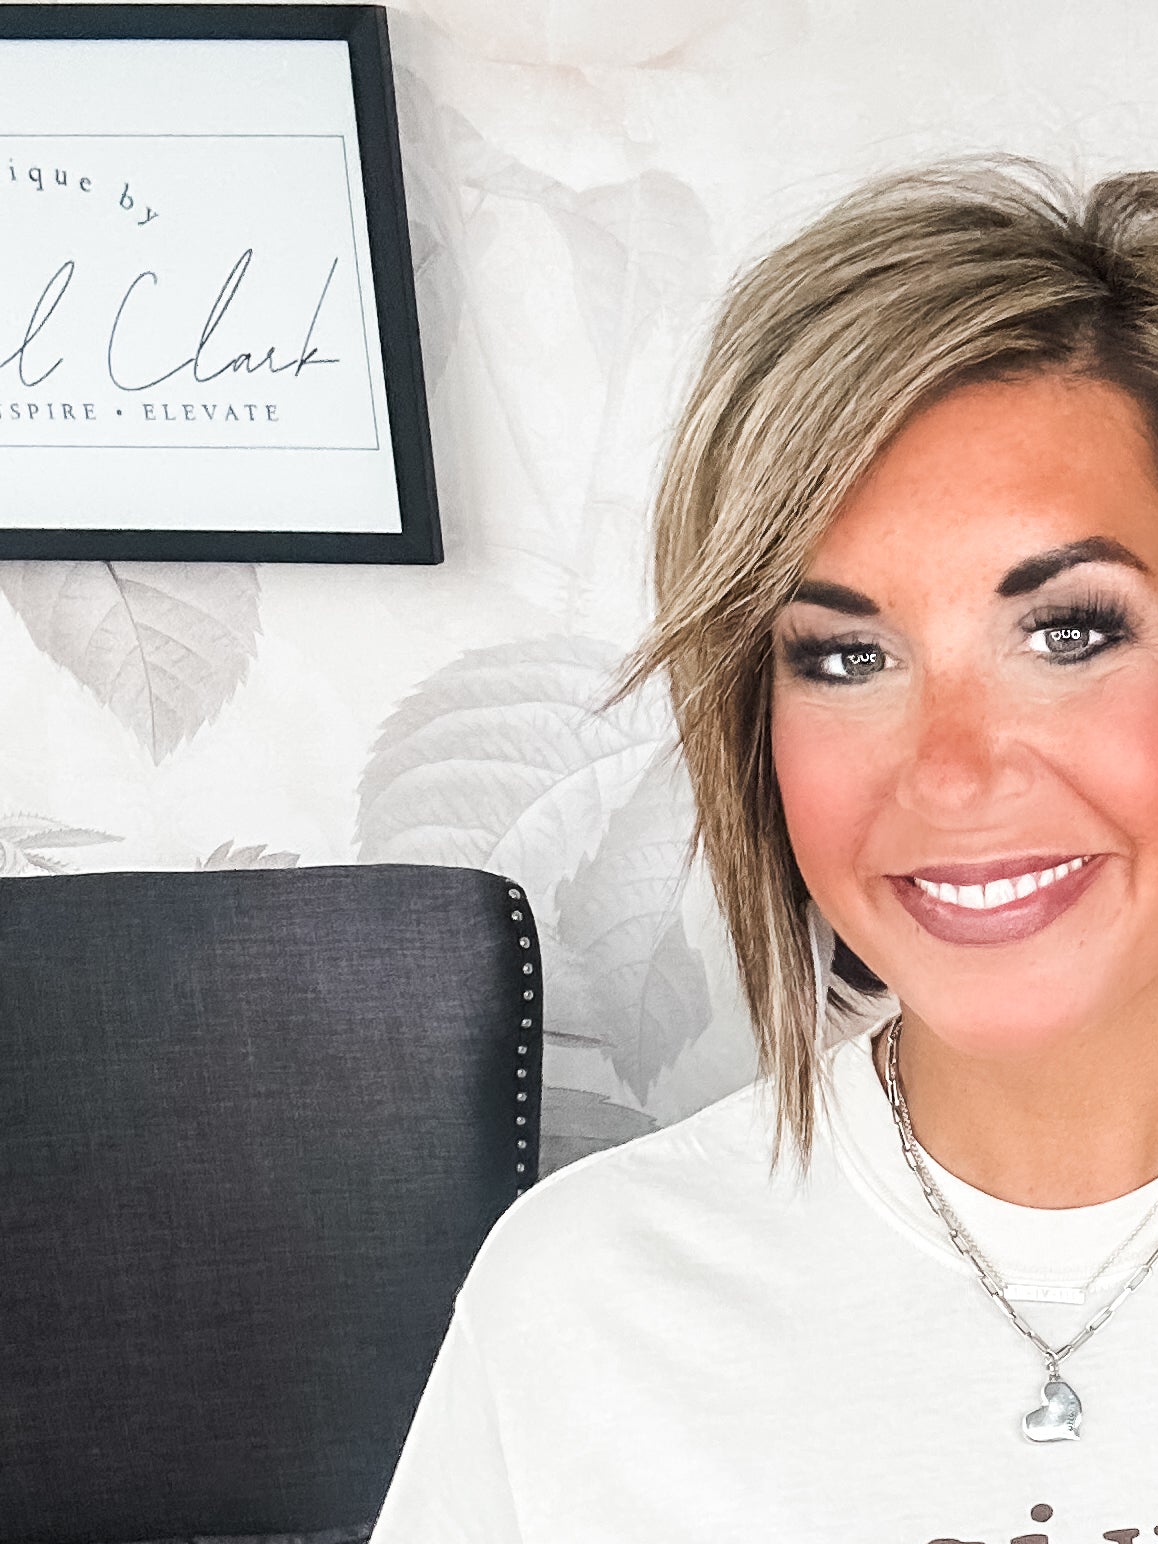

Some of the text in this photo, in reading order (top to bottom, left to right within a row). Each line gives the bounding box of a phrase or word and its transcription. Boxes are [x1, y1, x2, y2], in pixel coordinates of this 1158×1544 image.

[118, 181, 160, 226] by
[107, 248, 341, 392] Clark
[0, 402, 280, 423] SPIRE ELEVATE
